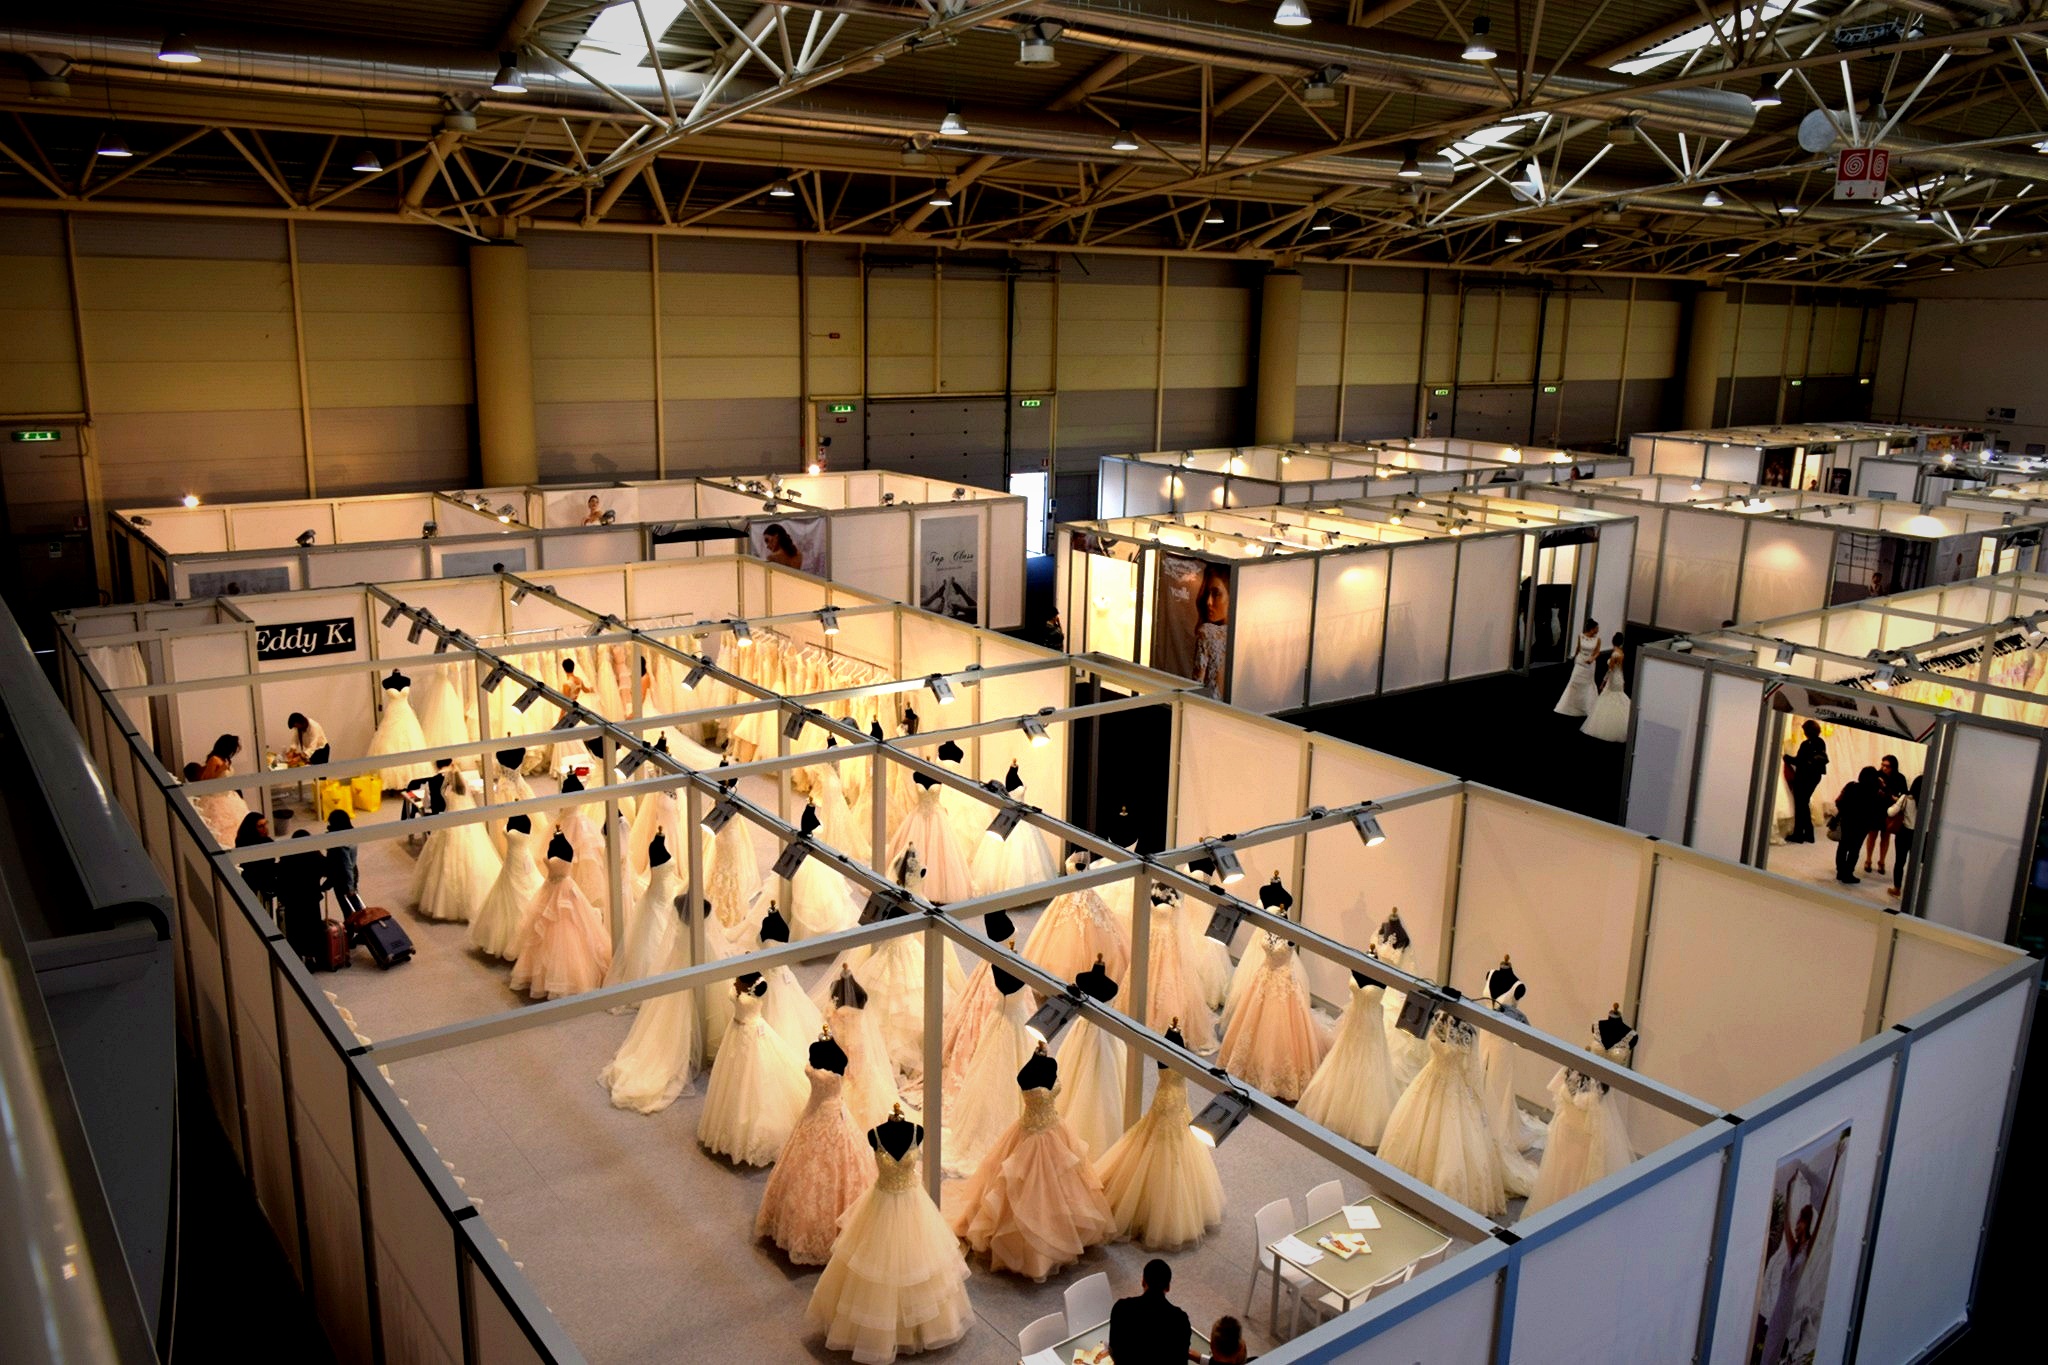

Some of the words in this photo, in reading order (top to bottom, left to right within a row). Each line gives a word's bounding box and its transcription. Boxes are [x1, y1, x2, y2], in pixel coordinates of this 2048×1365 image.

[929, 550, 944, 567] Top
[255, 626, 318, 654] Eddy
[324, 622, 353, 646] K.
